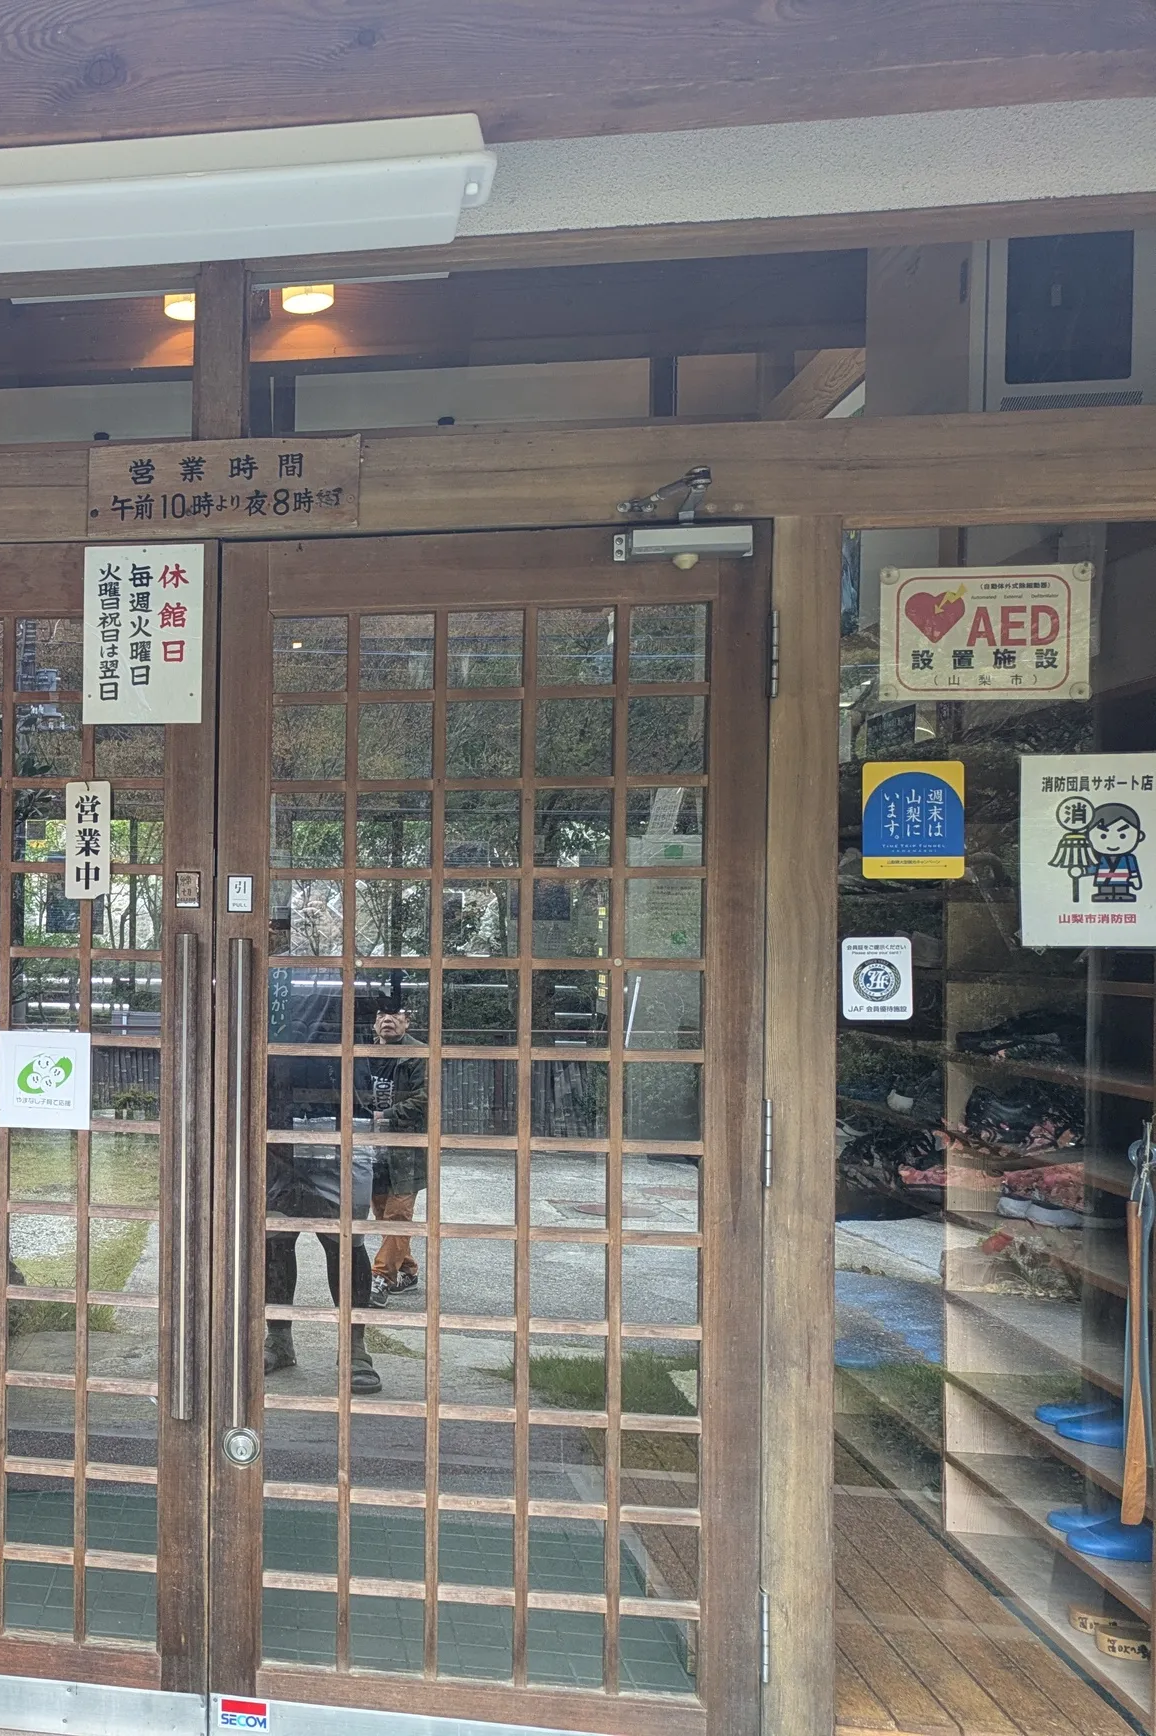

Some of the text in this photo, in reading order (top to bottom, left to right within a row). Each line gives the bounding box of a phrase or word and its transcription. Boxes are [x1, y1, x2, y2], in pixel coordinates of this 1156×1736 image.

[129, 452, 303, 485] 営業時間
[96, 562, 123, 701] 火曜日祝日は翌日
[128, 562, 154, 686] 毎週火曜日
[157, 562, 189, 663] 休館日
[966, 604, 1061, 648] AED
[910, 648, 1059, 671] 設置施設
[1041, 774, 1154, 793] 消防団員サポート店
[883, 791, 900, 840] います。
[905, 788, 923, 838] 山梨に
[926, 788, 945, 838] 週末は
[1064, 802, 1087, 824] 消
[75, 794, 101, 891] 営業中
[234, 880, 247, 895] 引
[1058, 913, 1137, 924] 山梨市消防団
[220, 1713, 267, 1729] SECOM
